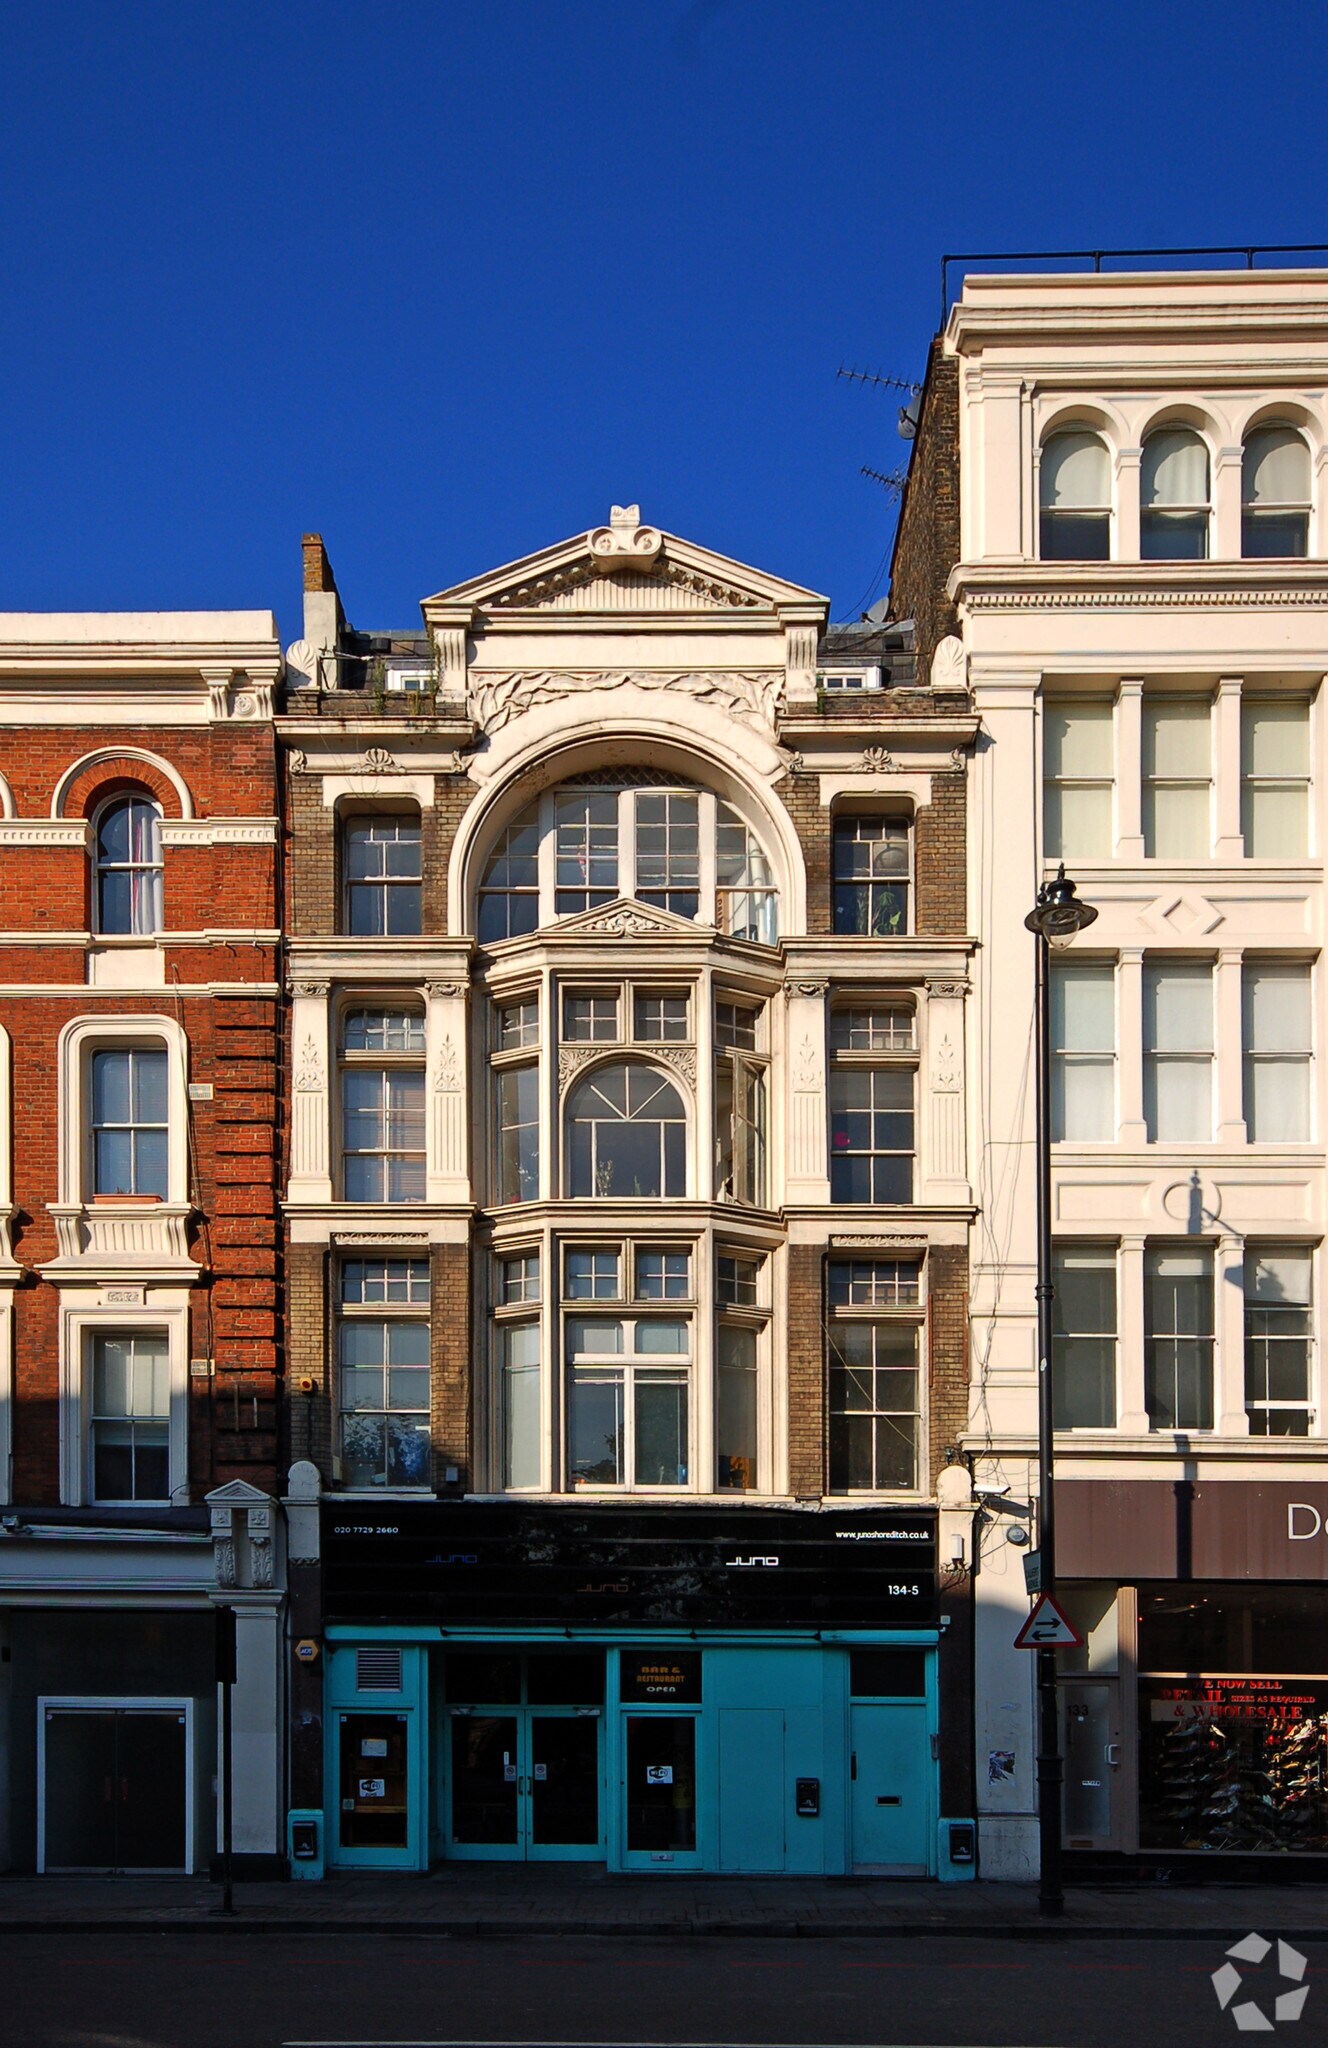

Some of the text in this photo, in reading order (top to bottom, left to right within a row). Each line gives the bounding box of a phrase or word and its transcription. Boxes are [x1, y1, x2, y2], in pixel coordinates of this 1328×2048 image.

[334, 1526, 351, 1534] 020
[353, 1526, 373, 1534] 7729
[424, 1554, 479, 1564] JUNO
[726, 1556, 780, 1566] JUNO
[887, 1585, 919, 1595] 134-5
[641, 1666, 669, 1674] BAR
[636, 1675, 686, 1683] RESTAURANT
[1216, 1680, 1247, 1689] NOW
[1249, 1680, 1283, 1690] SELL
[1270, 1696, 1316, 1704] REQUIRED
[1067, 1704, 1089, 1716] 133
[1174, 1704, 1304, 1720] & WHOLESALE
